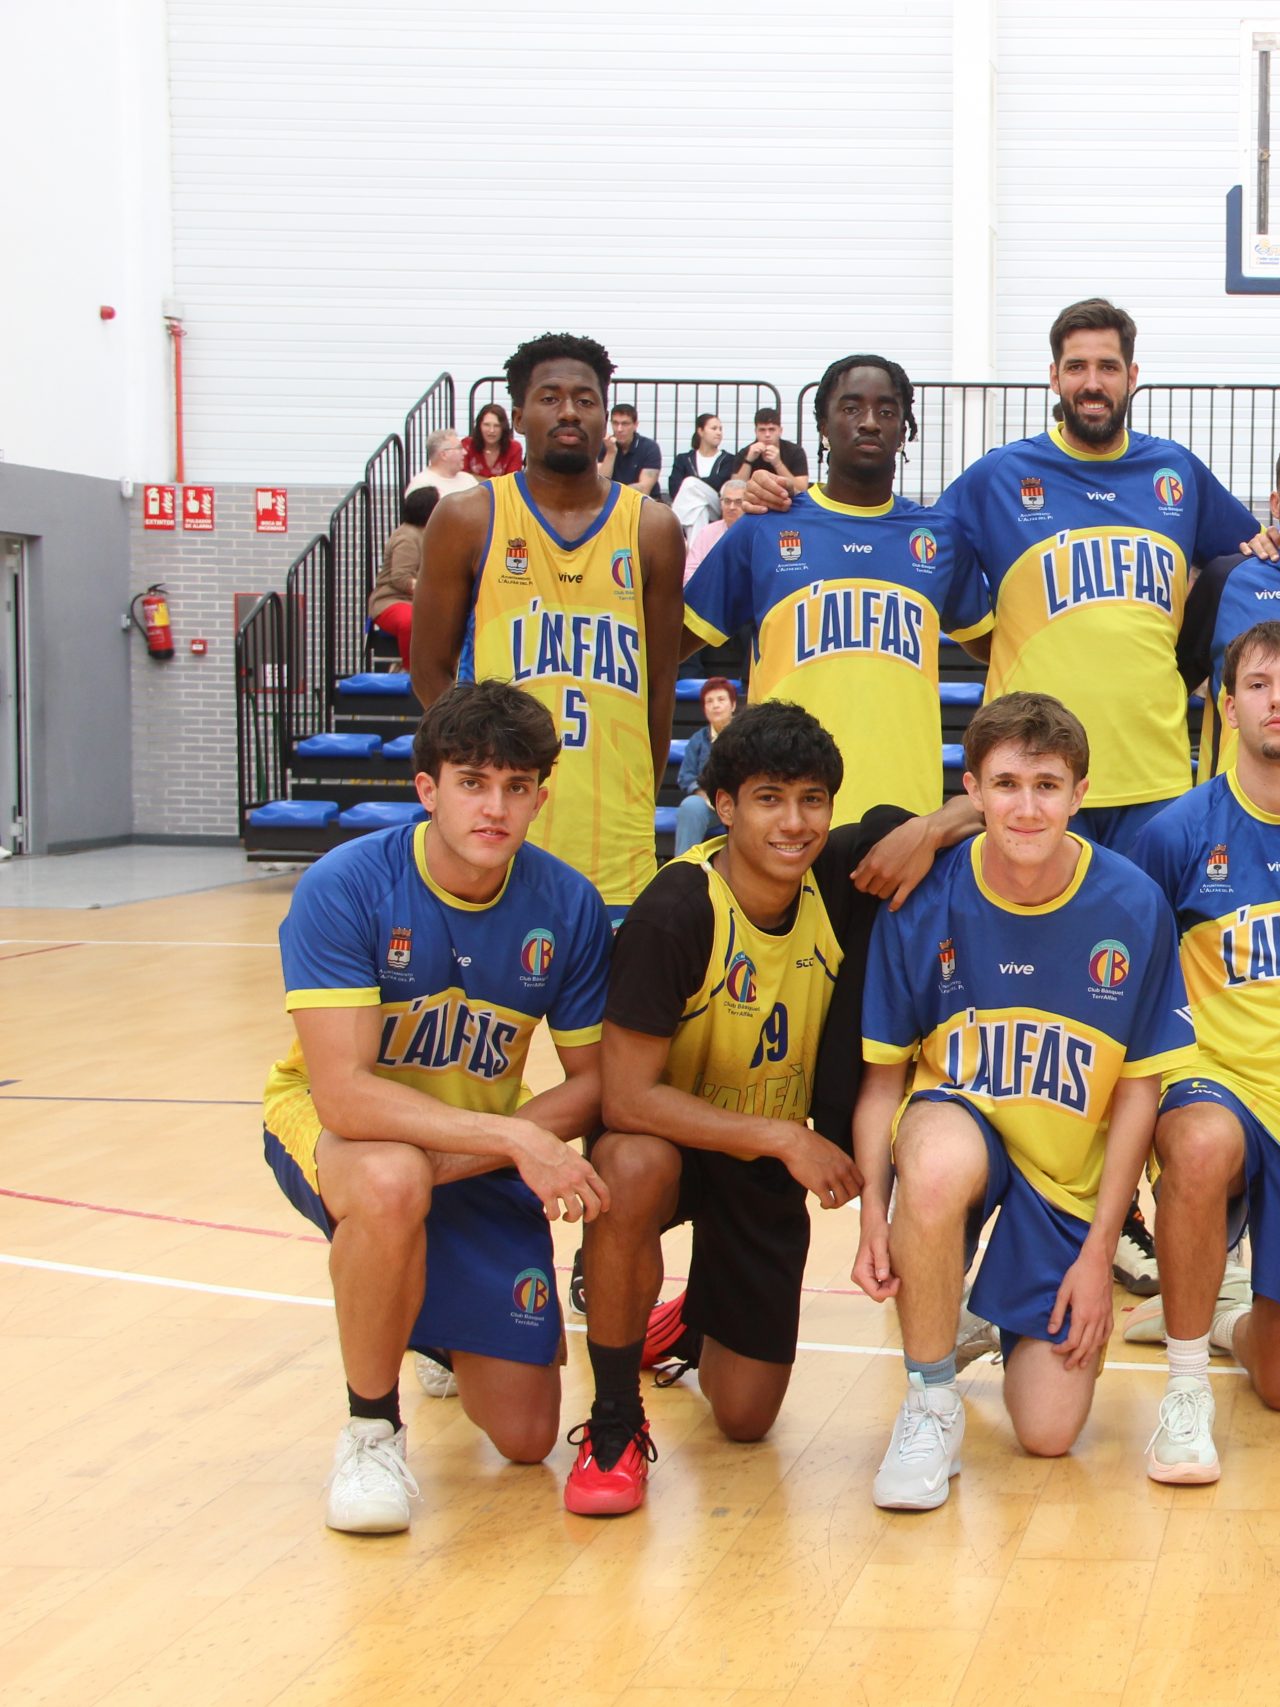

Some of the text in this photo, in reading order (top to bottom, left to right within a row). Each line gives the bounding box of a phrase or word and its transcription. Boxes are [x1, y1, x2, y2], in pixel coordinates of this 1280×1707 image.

[1086, 491, 1116, 501] vive
[843, 543, 873, 554] vive
[558, 572, 583, 584] vive
[563, 686, 591, 749] 5
[999, 961, 1034, 975] vive
